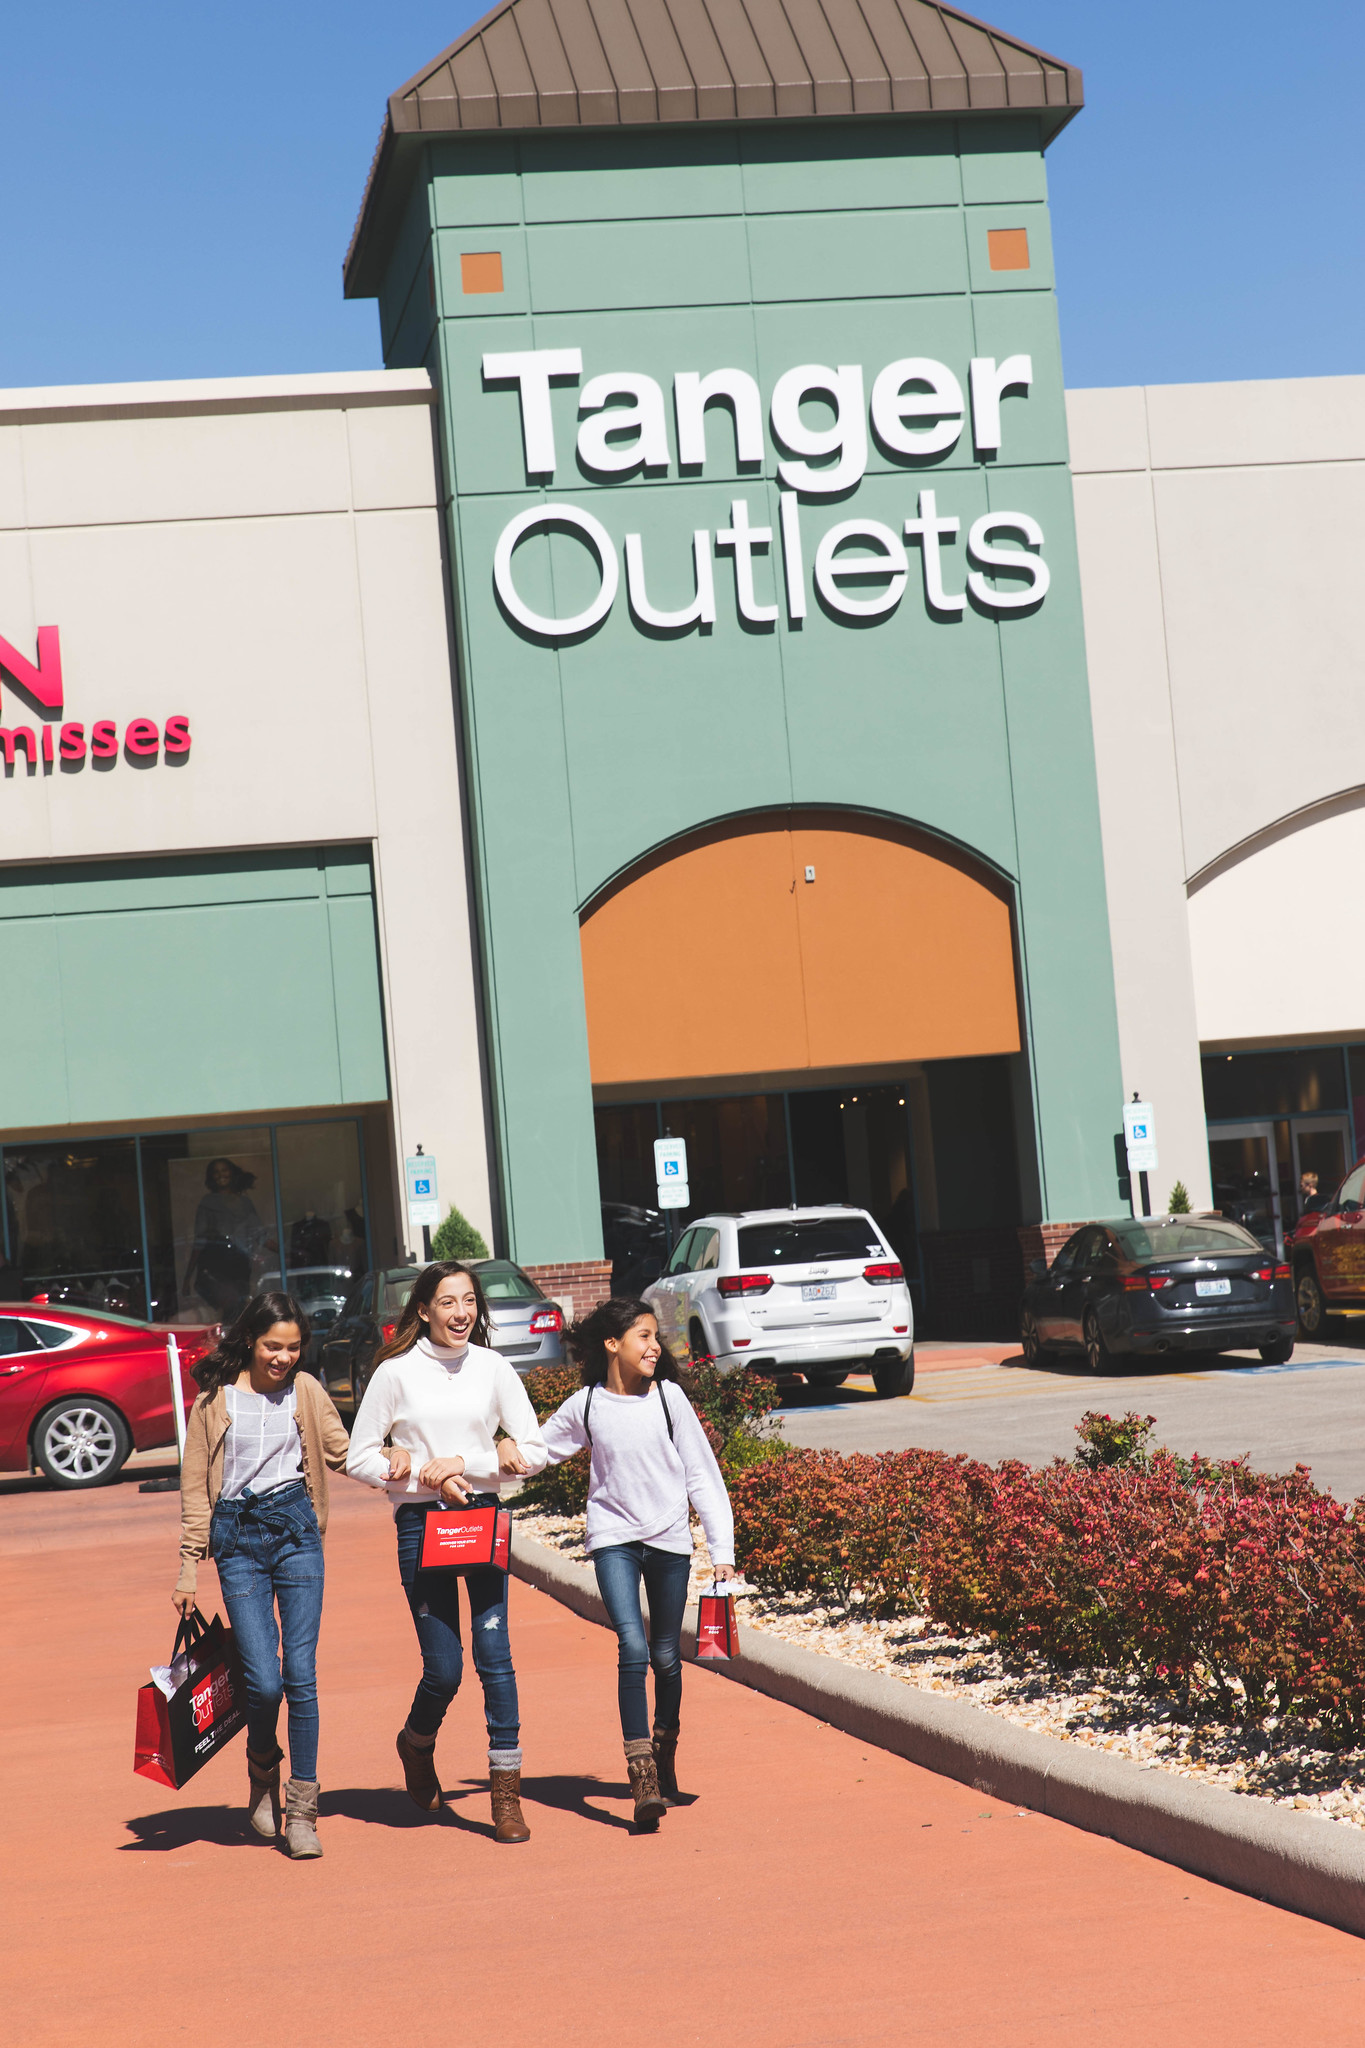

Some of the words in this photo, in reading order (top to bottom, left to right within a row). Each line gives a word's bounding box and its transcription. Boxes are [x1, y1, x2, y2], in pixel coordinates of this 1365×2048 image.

[482, 347, 1033, 492] Tanger
[494, 489, 1051, 635] Outlets
[0, 715, 192, 764] misses
[436, 1525, 483, 1535] TangerOutlets
[188, 1668, 231, 1712] Tanger
[191, 1683, 235, 1727] Outlets
[194, 1736, 211, 1754] FEEL
